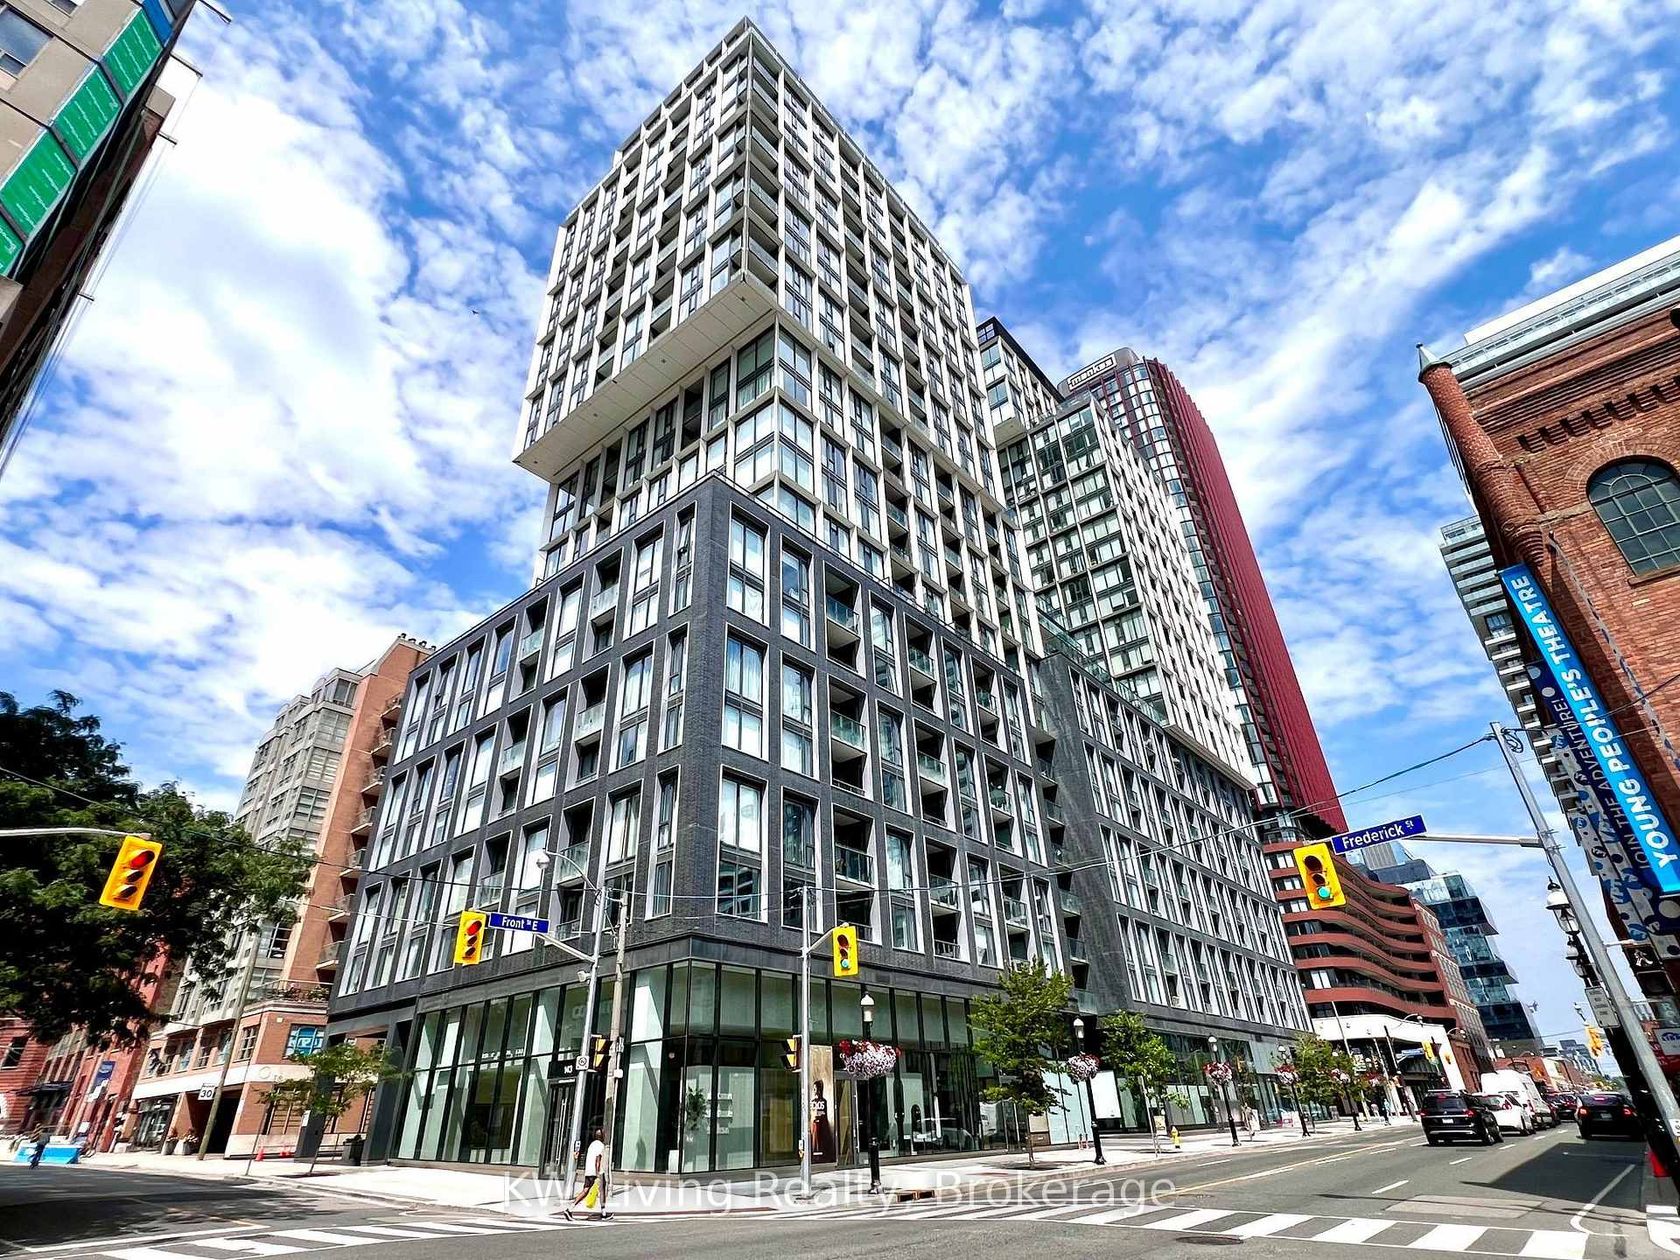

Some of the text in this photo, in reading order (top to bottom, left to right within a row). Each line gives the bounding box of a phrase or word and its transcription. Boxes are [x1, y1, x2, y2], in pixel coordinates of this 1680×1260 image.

[1511, 575, 1678, 868] YOUNG PEOPLE'S THEATRE
[1551, 697, 1613, 790] ADVENTURE!
[1604, 797, 1630, 829] THE
[1341, 823, 1405, 849] Frederick
[501, 916, 525, 929] Front
[532, 920, 539, 931] E
[200, 1089, 213, 1098] 30
